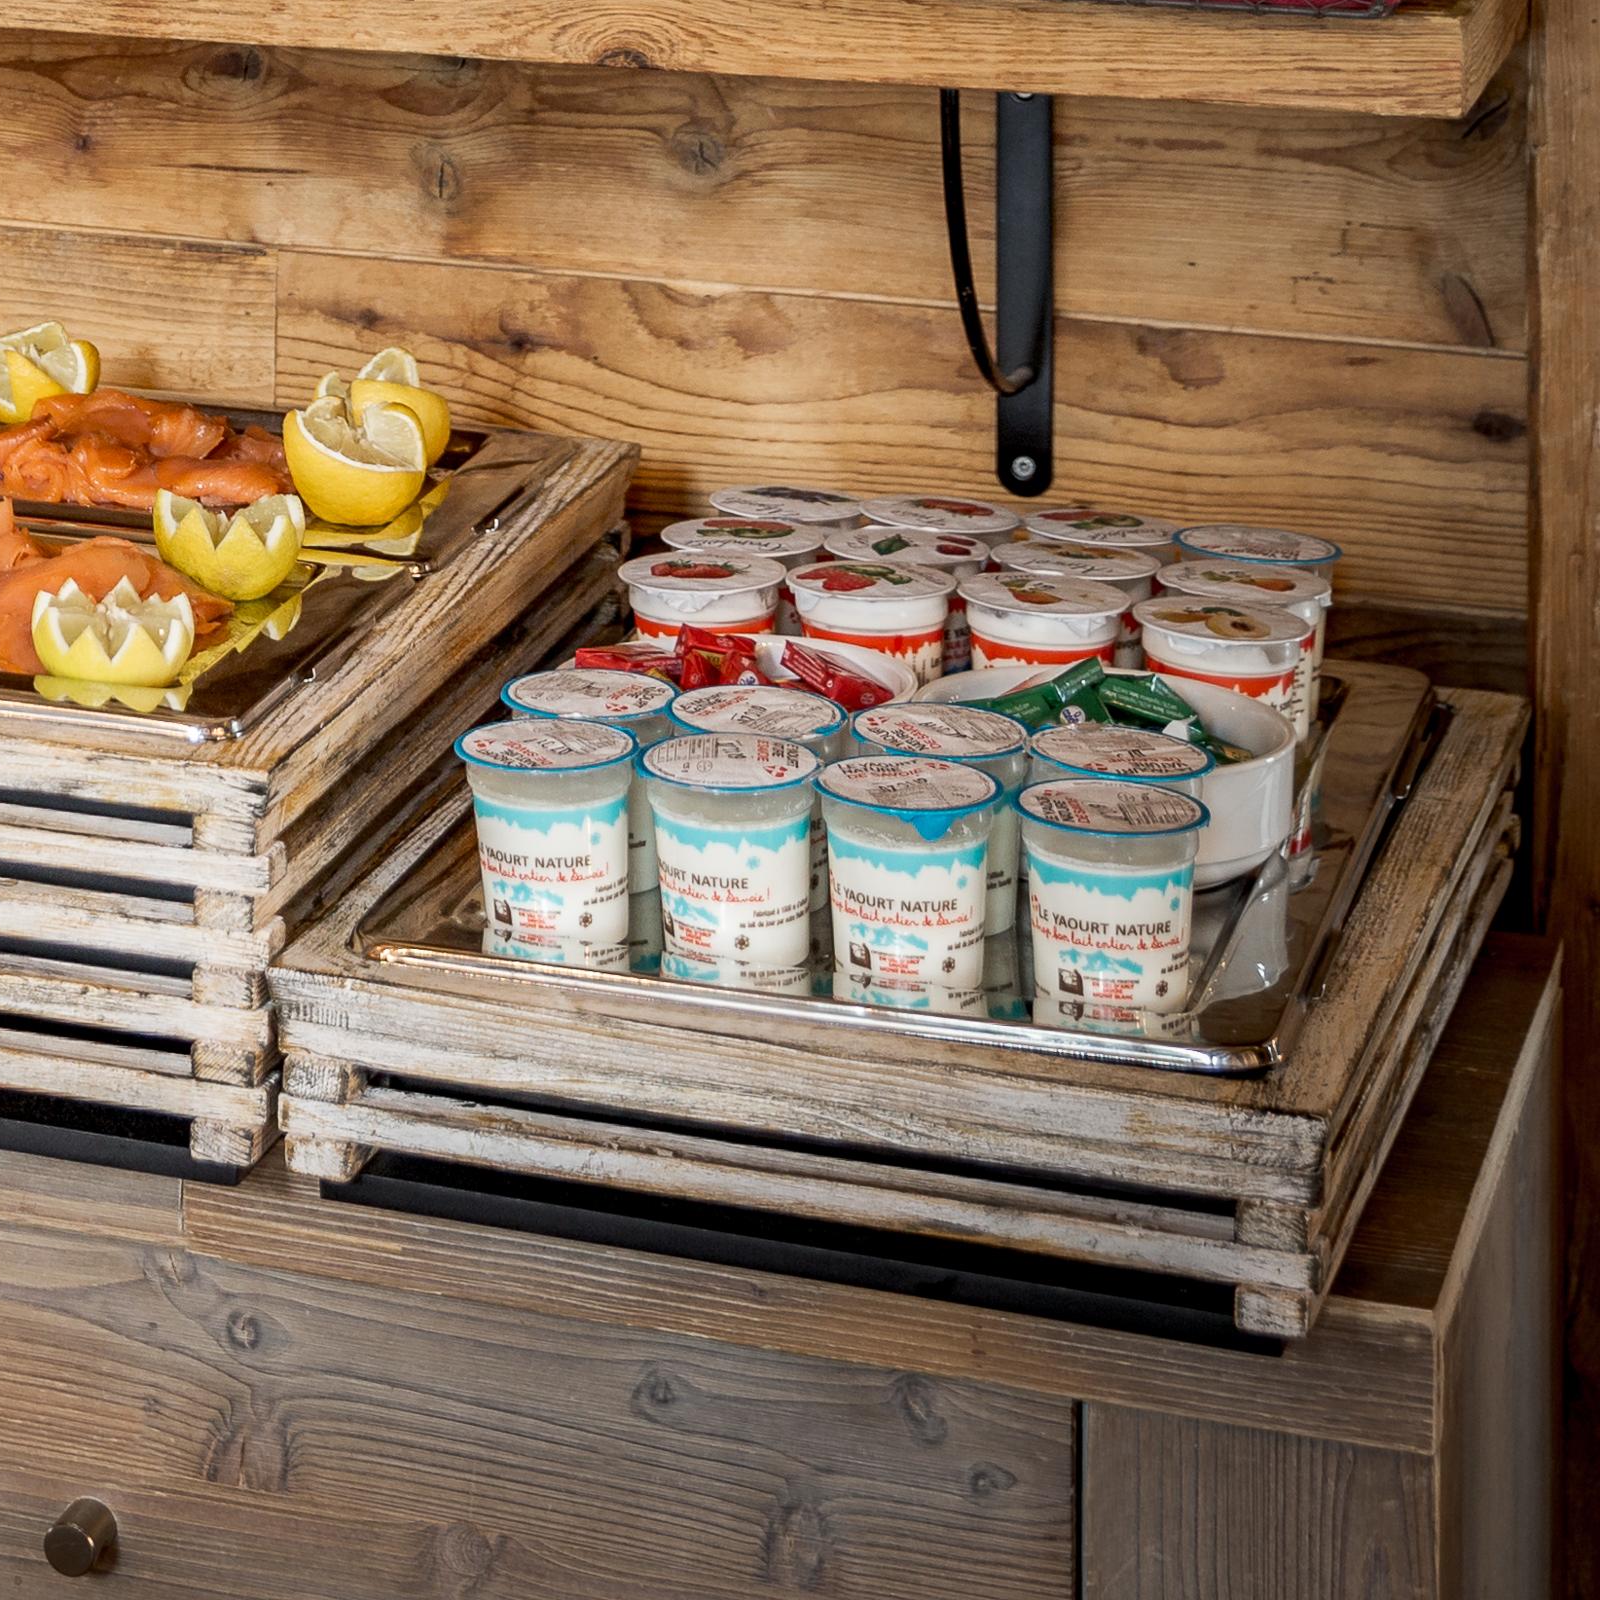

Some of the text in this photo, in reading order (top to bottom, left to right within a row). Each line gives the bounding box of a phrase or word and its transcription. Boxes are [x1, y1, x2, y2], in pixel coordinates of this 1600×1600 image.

[485, 844, 529, 868] YAOURT
[534, 854, 592, 869] NATURE
[691, 872, 750, 890] NATURE
[843, 886, 896, 911] YAOURT
[900, 897, 958, 912] NATURE
[1038, 903, 1172, 937] LE YAOURT NATURE
